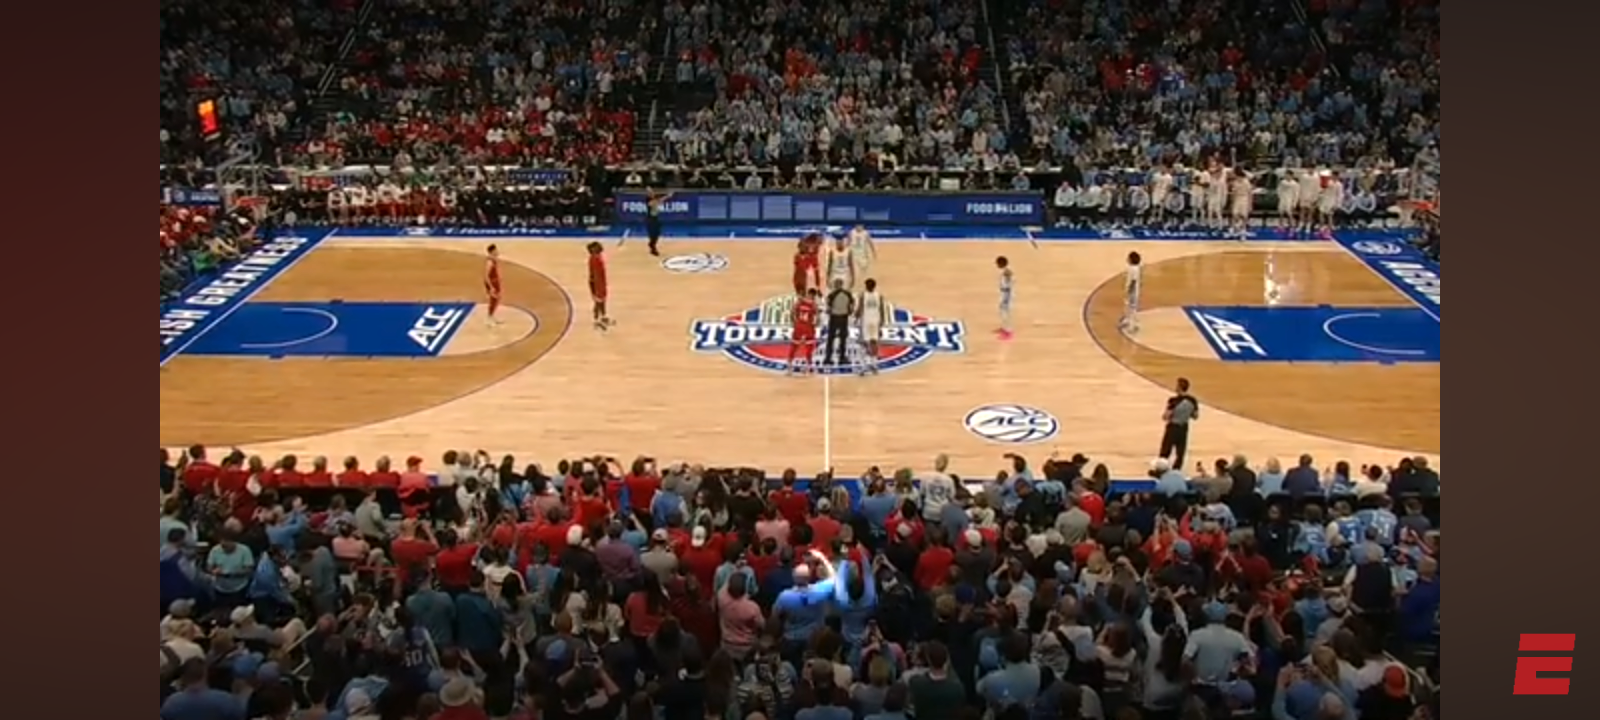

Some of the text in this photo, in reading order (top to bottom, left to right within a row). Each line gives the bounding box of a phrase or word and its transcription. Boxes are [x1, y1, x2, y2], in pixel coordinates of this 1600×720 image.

[966, 202, 1033, 213] FOOD LION
[185, 237, 308, 305] GREATNESS
[406, 306, 455, 348] ACC
[699, 321, 957, 348] TOURENT
[1202, 313, 1268, 357] ACC
